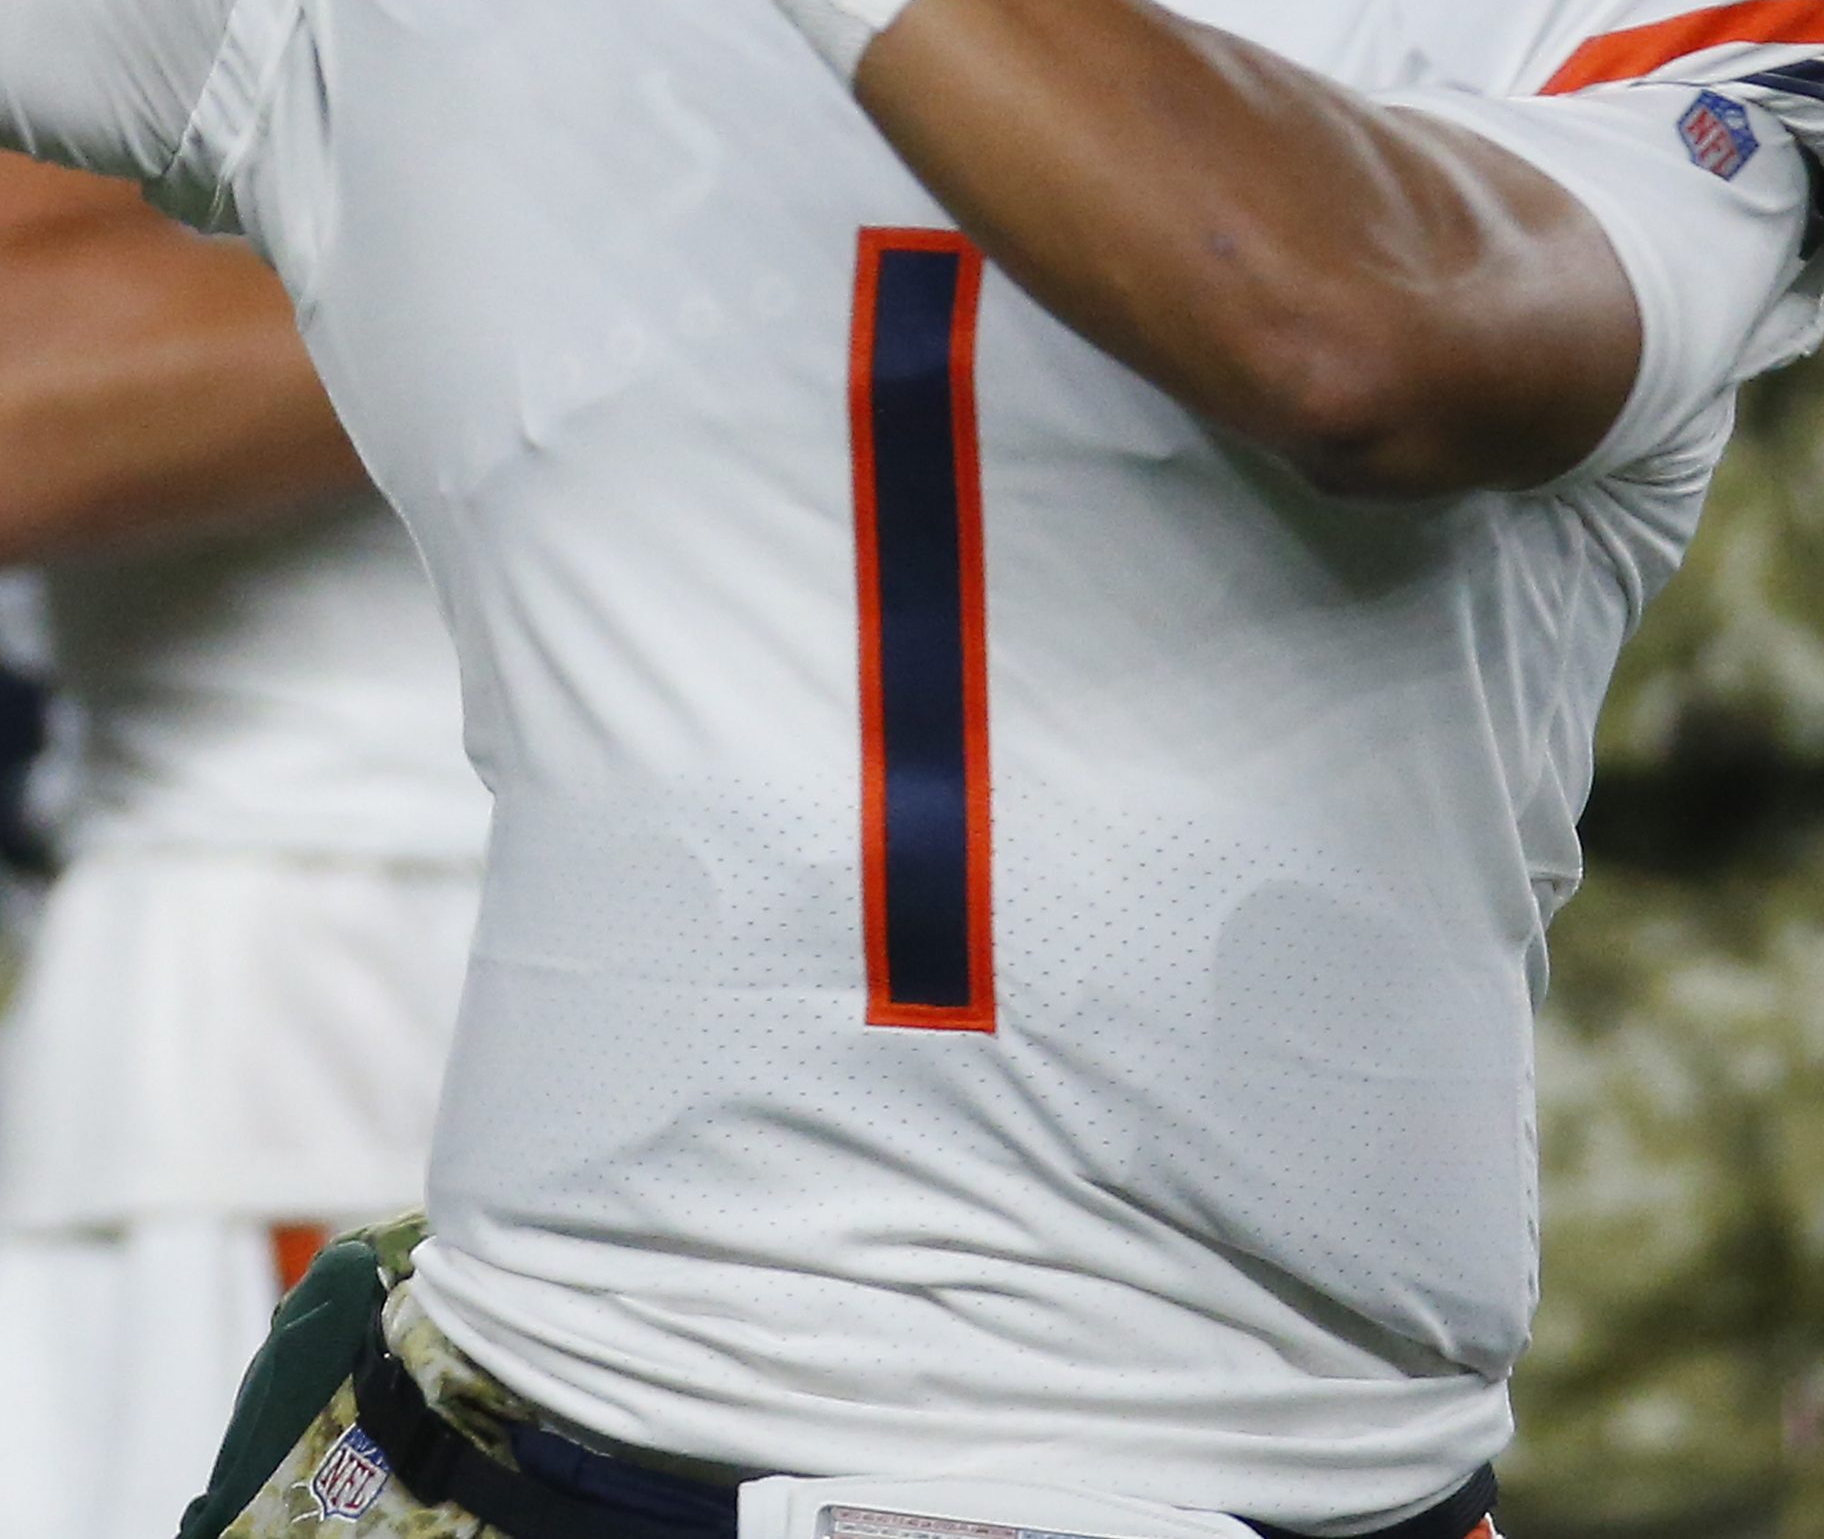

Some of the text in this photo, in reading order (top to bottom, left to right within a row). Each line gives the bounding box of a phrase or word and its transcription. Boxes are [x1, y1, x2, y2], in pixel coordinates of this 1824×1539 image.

[1685, 107, 1738, 177] NFL
[848, 225, 996, 1032] 1
[319, 1445, 376, 1511] NFL
